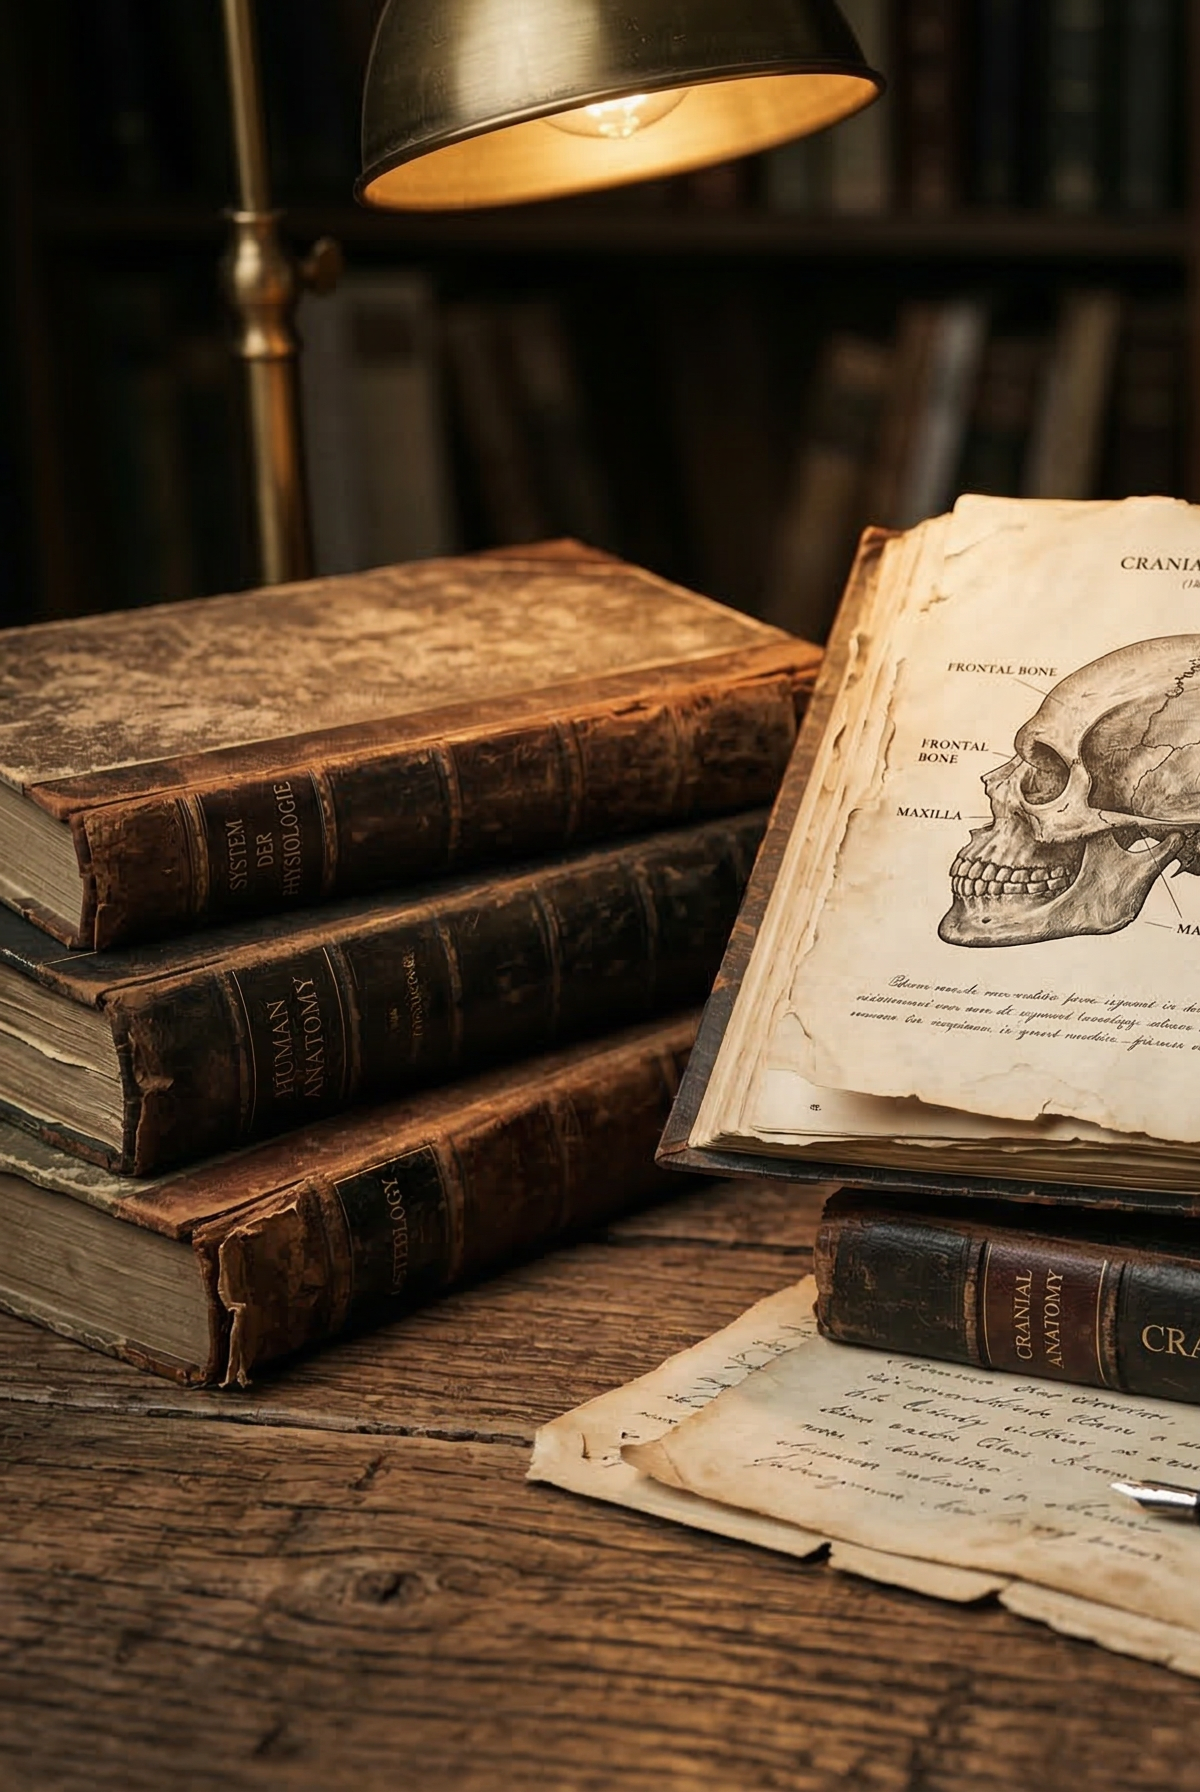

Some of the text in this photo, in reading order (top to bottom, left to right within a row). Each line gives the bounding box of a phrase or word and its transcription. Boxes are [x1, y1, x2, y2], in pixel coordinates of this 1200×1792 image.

[947, 662, 1058, 677] FRONTAL BONE
[917, 753, 959, 765] BONE
[921, 738, 989, 752] FRONTAL
[896, 806, 962, 821] MAXILLA
[225, 819, 248, 891] SYSTEM
[256, 832, 274, 868] DER
[266, 999, 294, 1098] HUMAN
[292, 977, 322, 1098] ANATOMY
[1014, 1269, 1033, 1360] CRANIAL
[1043, 1268, 1065, 1369] ANATOMY
